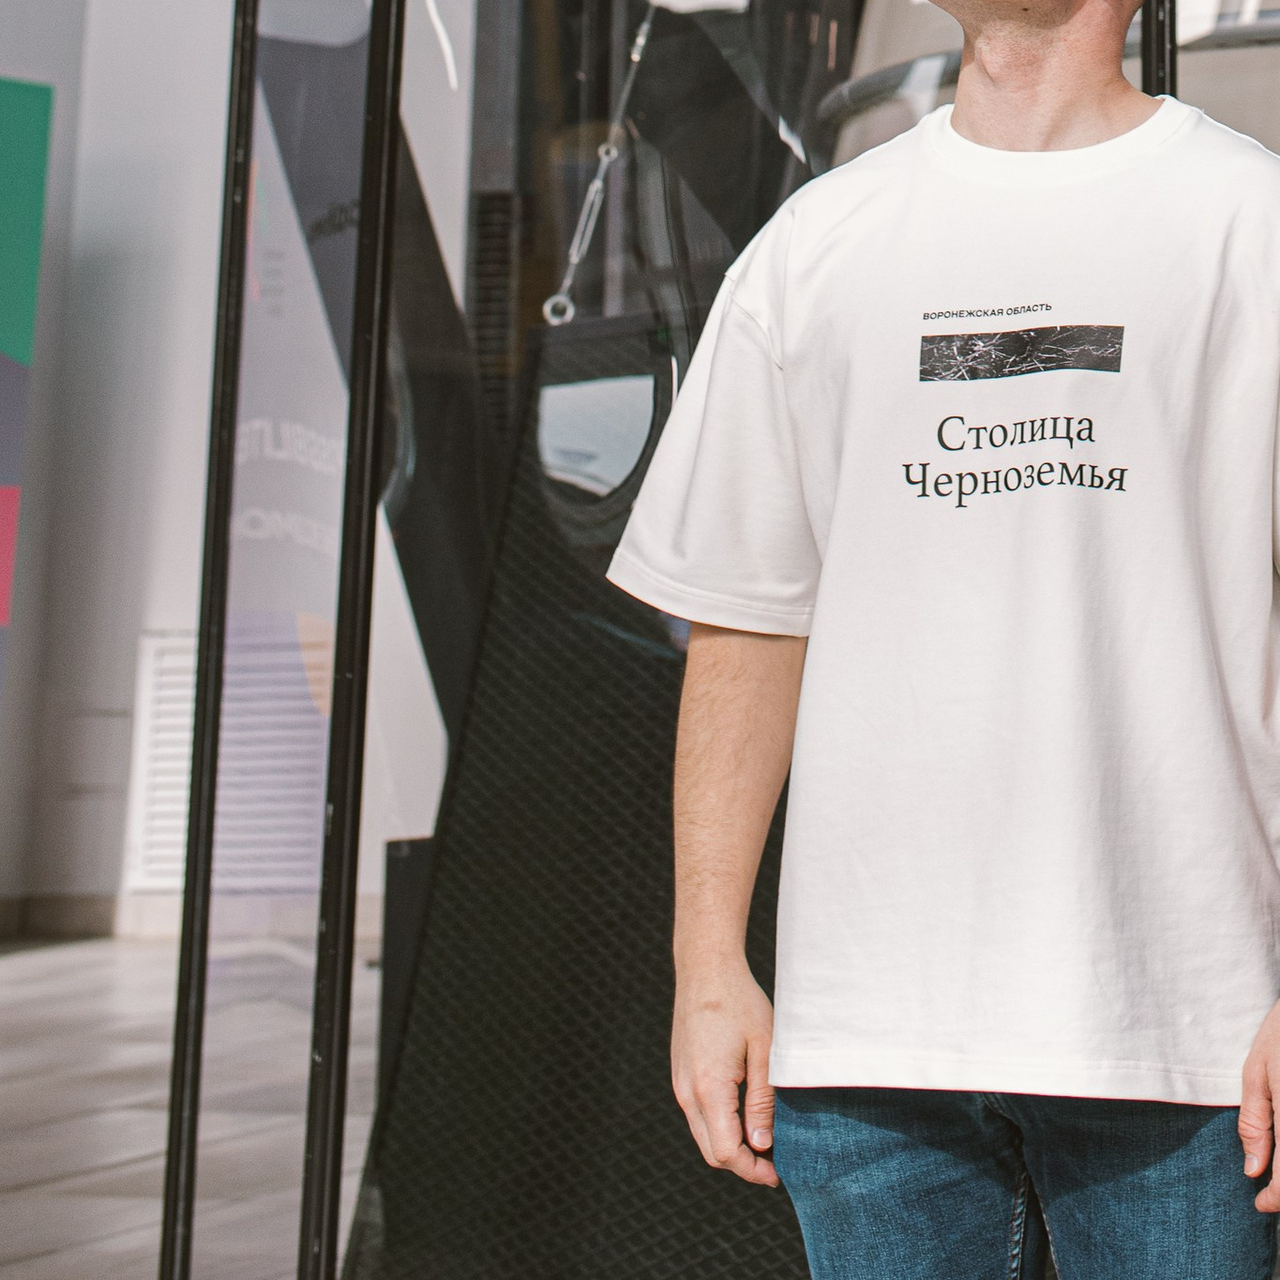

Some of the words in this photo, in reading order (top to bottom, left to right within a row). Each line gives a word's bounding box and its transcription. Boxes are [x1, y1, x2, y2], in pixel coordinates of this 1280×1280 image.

[922, 308, 1004, 321] ВОРОНЕЖСКАЯ
[1005, 303, 1053, 316] ОБЛАСТЬ
[936, 415, 1096, 452] Столица
[902, 460, 1129, 509] Черноземья
